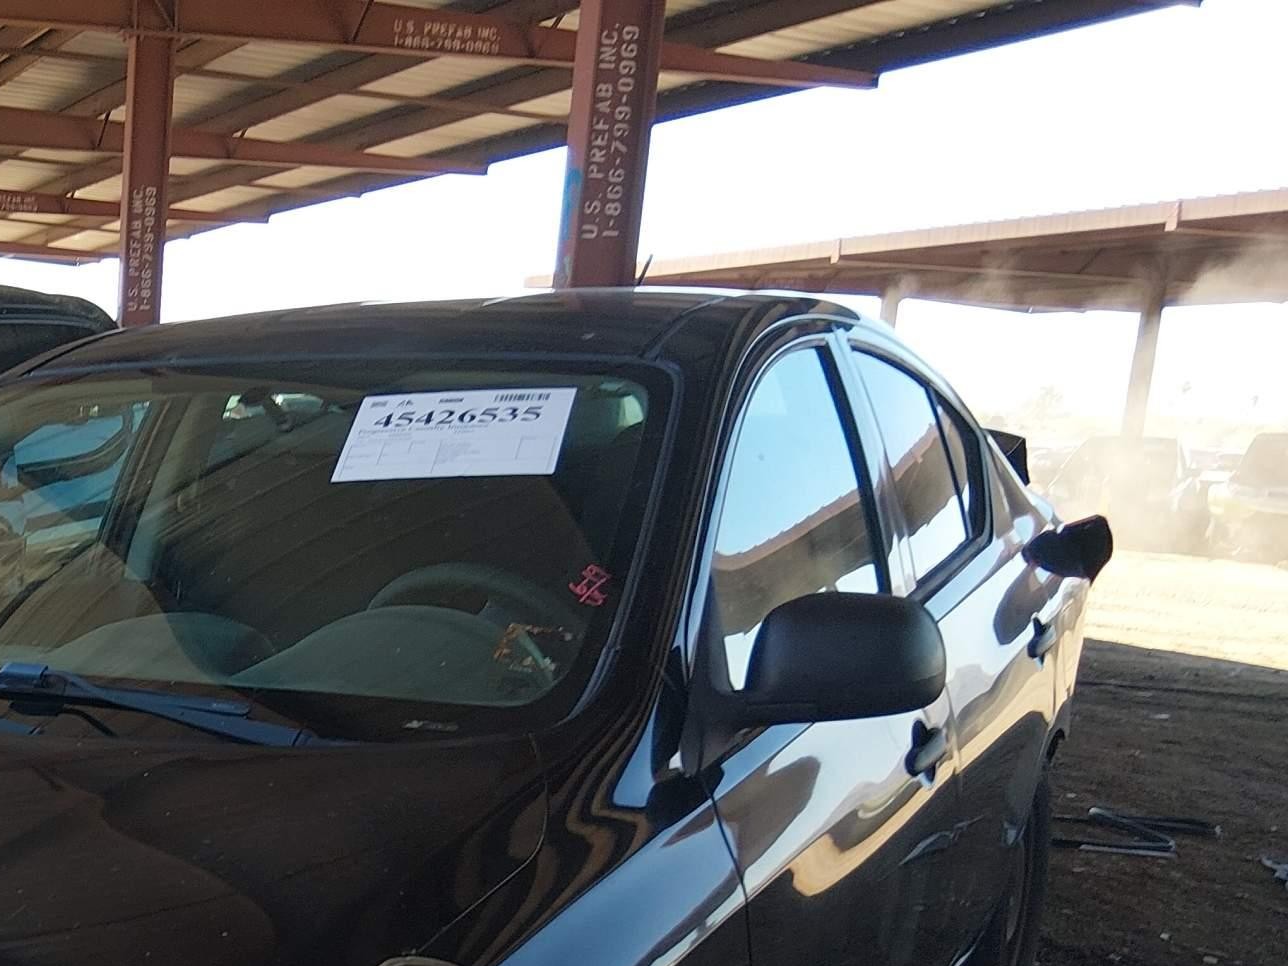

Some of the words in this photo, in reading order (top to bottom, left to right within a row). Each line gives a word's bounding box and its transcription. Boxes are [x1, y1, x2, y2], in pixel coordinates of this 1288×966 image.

[423, 21, 473, 40] PREFAB
[598, 23, 620, 70] INC.
[587, 82, 613, 180] PREFAB
[601, 24, 641, 239] 1-866-799-0969
[581, 192, 602, 240] U.S.
[129, 220, 143, 277] PREFAB
[373, 405, 544, 429] 45426535
